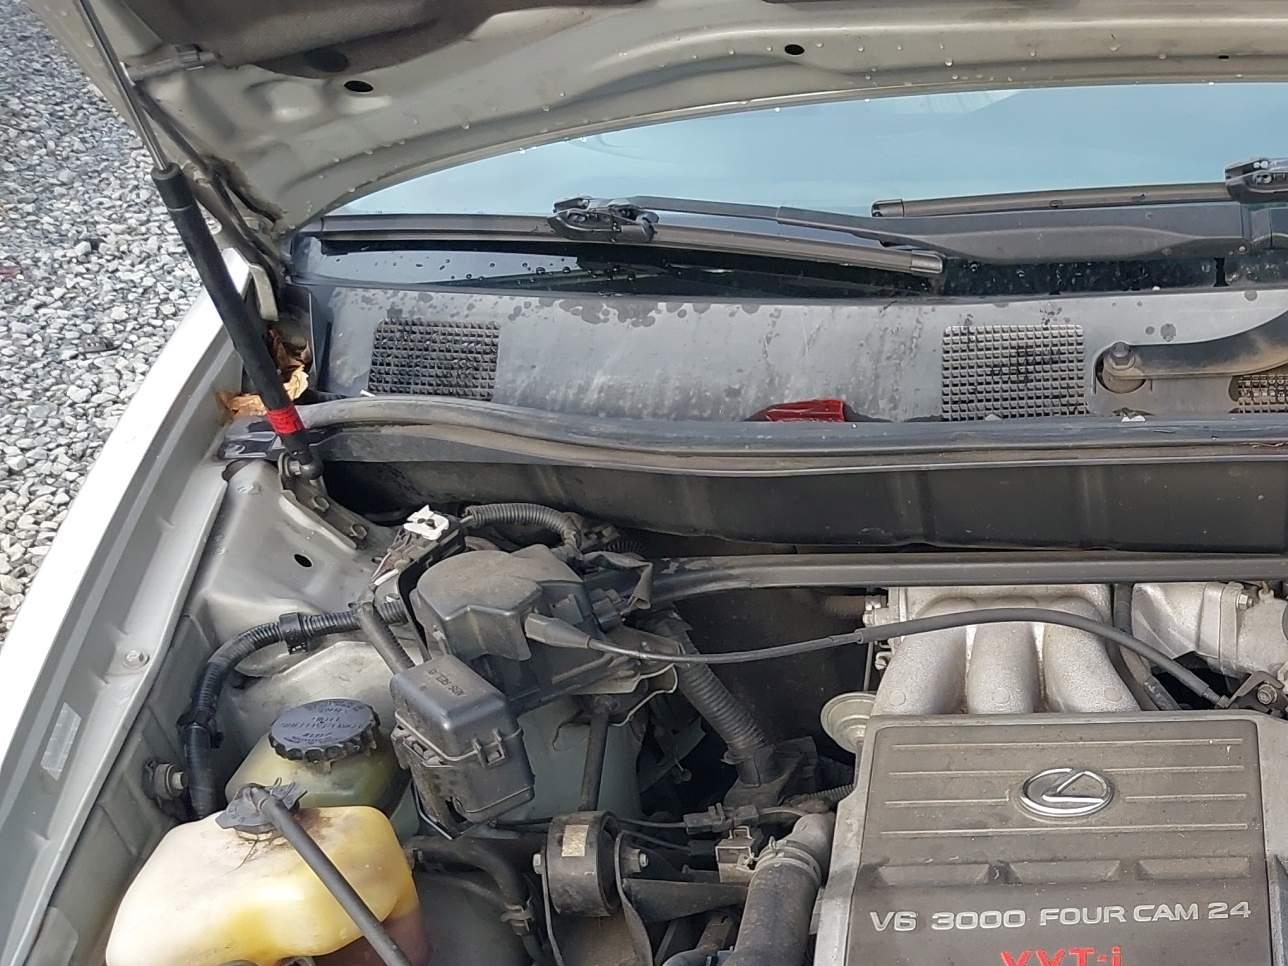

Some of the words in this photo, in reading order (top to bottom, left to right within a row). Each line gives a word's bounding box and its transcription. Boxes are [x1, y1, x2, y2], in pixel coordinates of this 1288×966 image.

[870, 910, 918, 932] V6
[931, 909, 1027, 931] 3000
[1039, 903, 1125, 927] FOUR
[1132, 902, 1200, 923] CAM
[1207, 900, 1252, 920] 24
